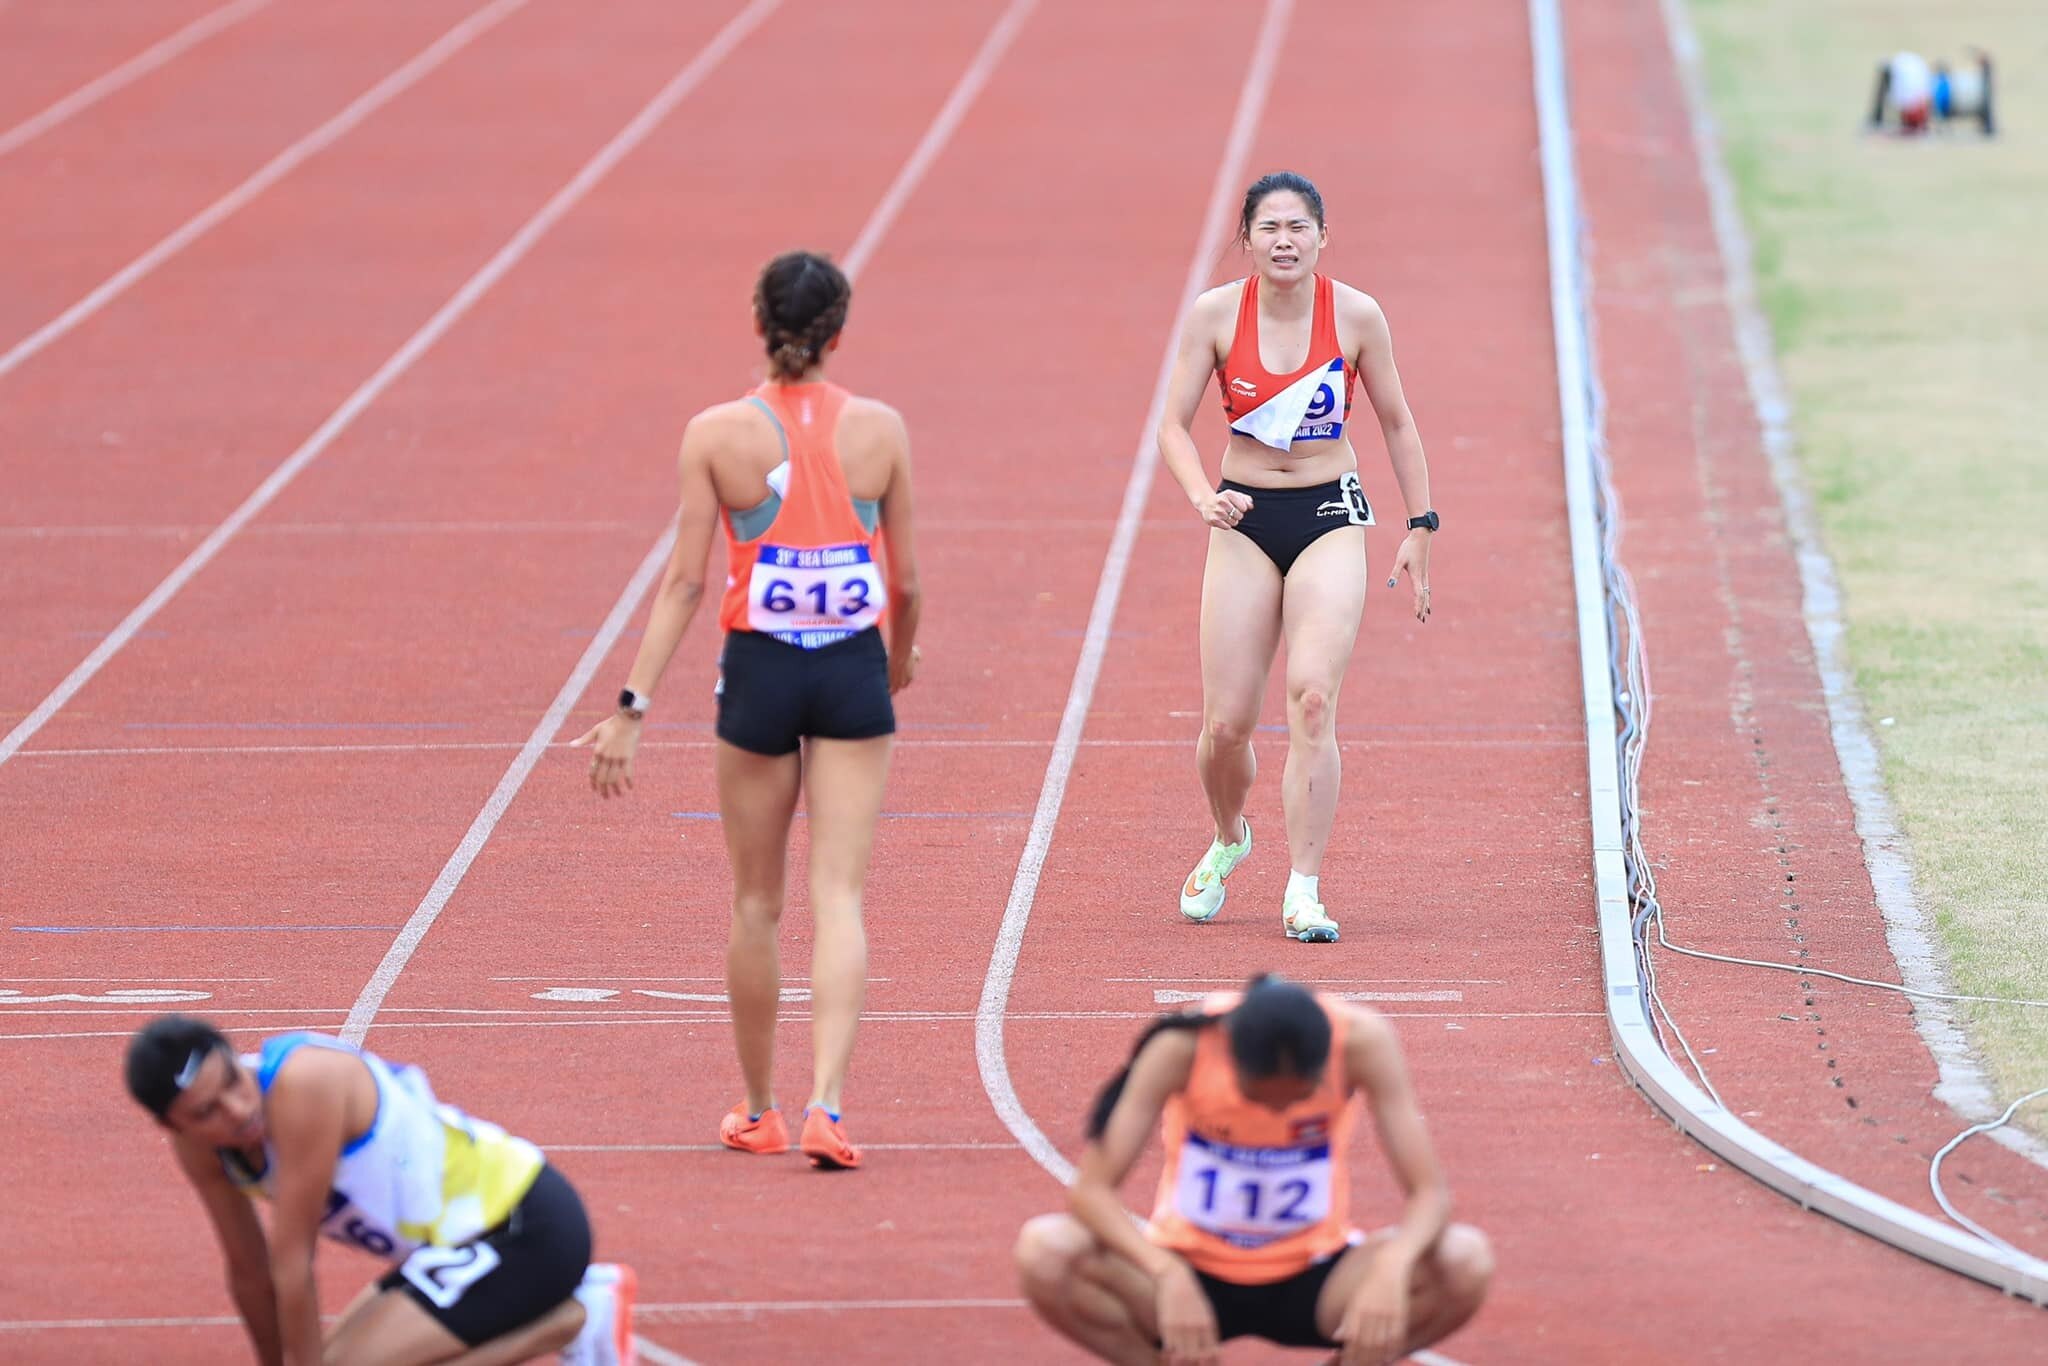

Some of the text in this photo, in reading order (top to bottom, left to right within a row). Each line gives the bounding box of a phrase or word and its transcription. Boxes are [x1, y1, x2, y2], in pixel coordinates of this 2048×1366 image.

[1311, 424, 1333, 436] 2022
[797, 550, 821, 567] SEA
[762, 578, 869, 616] 613
[1196, 1167, 1311, 1221] 112
